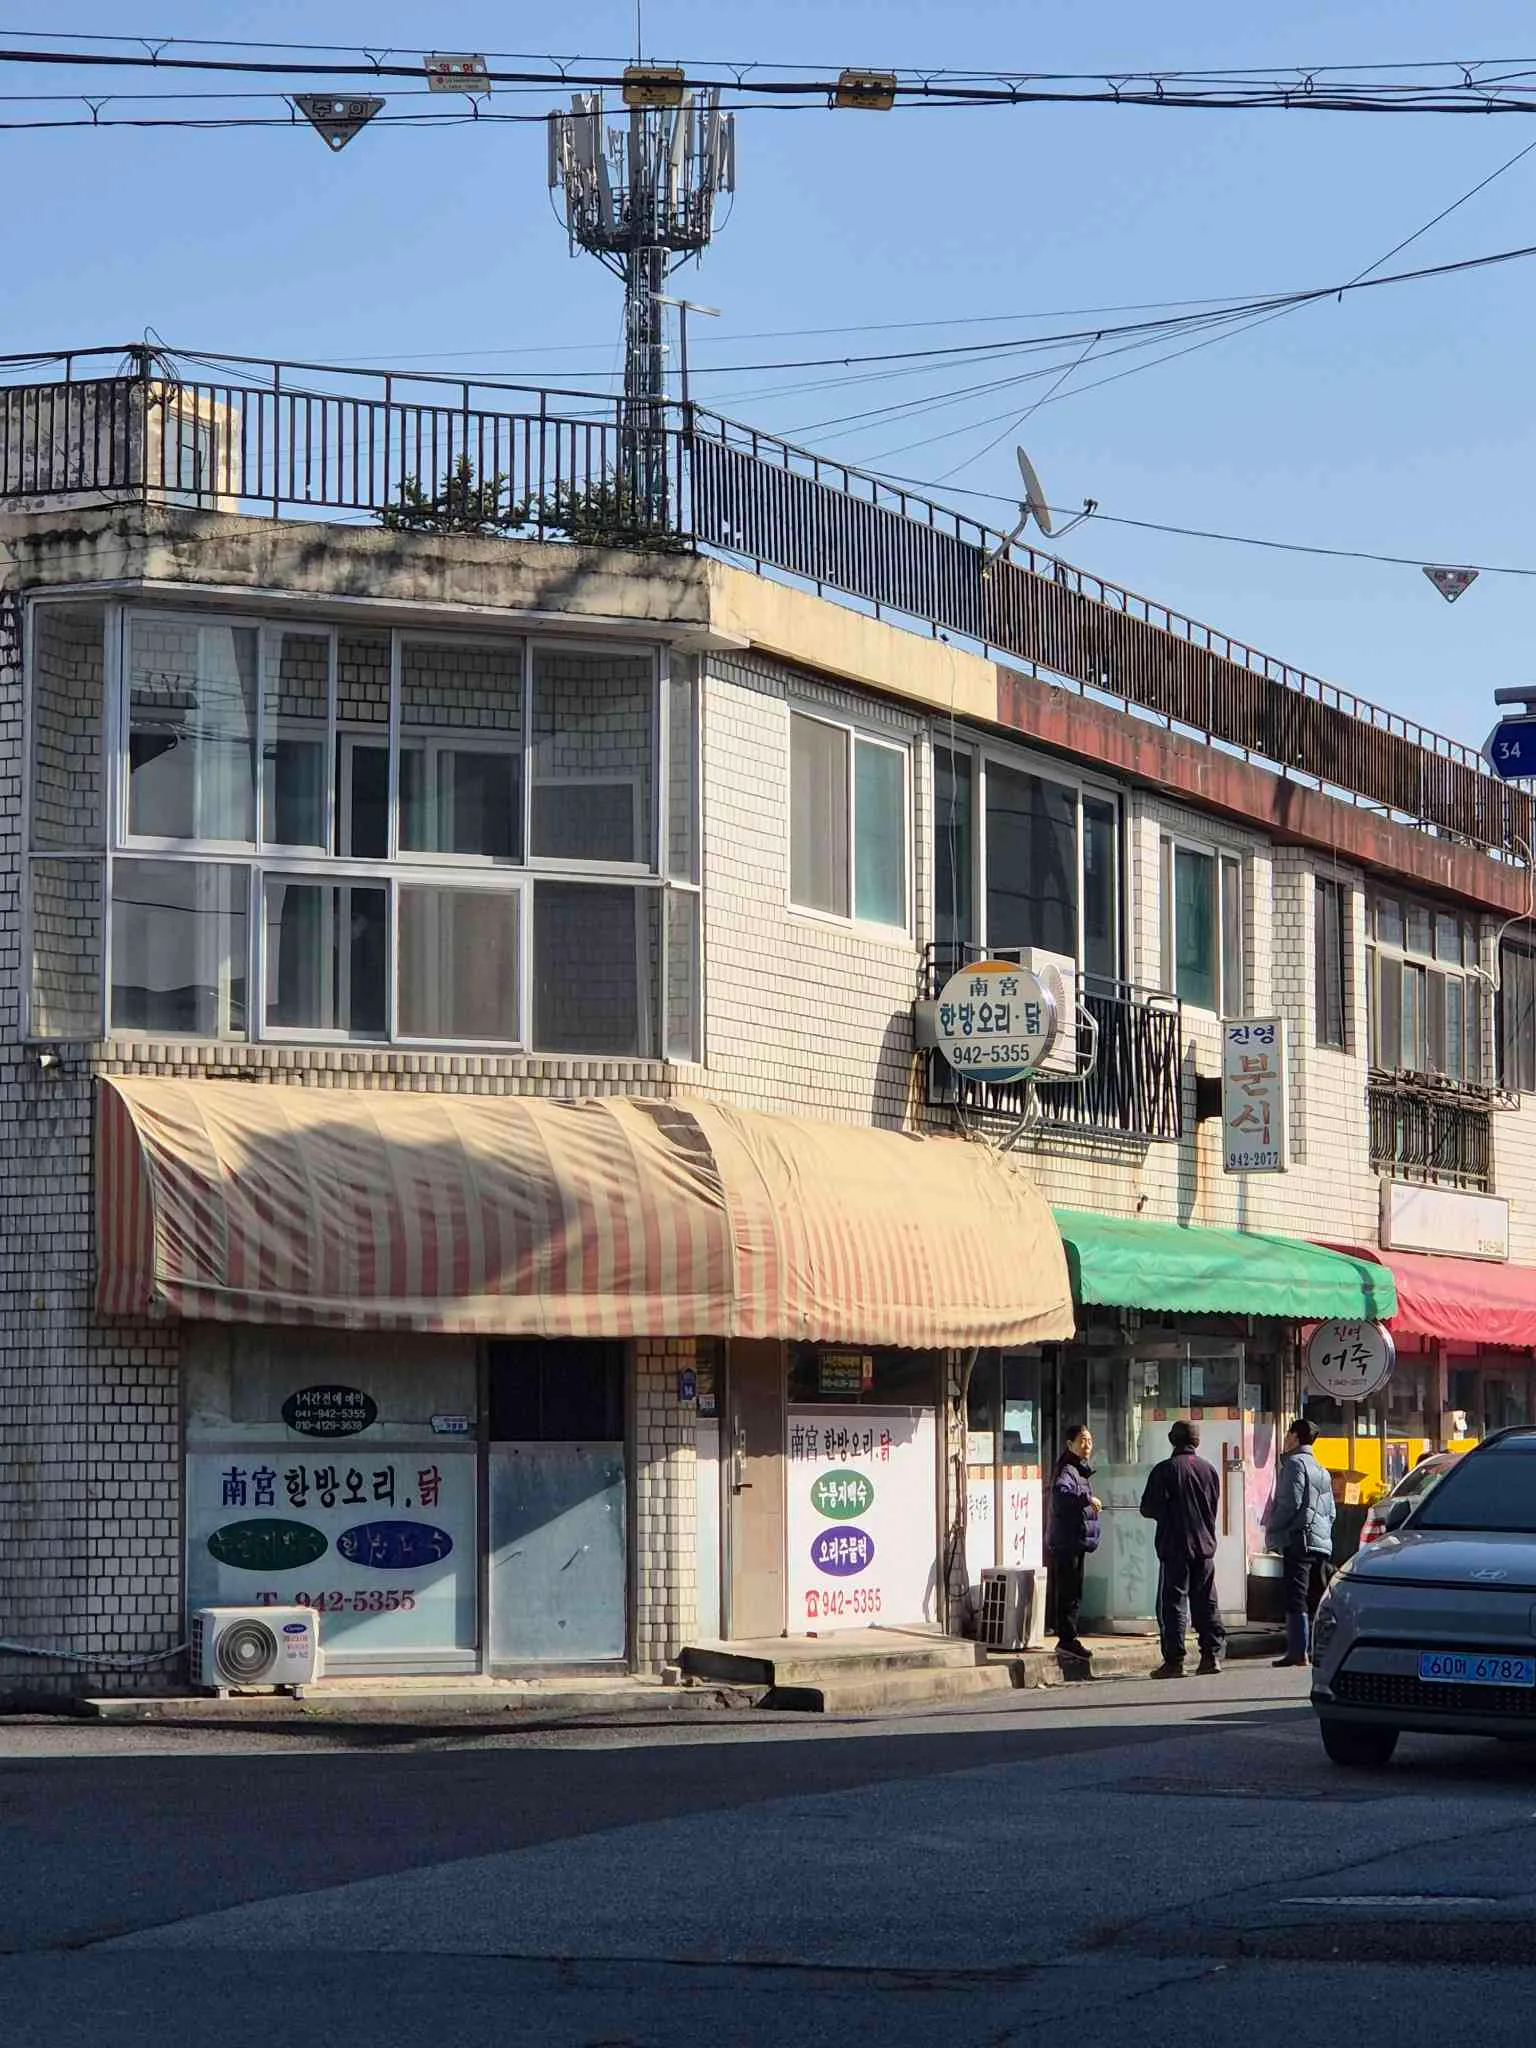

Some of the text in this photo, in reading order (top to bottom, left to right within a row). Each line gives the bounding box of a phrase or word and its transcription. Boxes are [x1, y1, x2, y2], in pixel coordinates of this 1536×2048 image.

[1500, 742, 1522, 759] 34
[1229, 1025, 1275, 1045] 진영
[953, 1044, 1030, 1064] 942-5355
[1230, 1053, 1277, 1144] 분식
[1230, 1152, 1278, 1167] 942-2077
[1322, 1343, 1373, 1376] 어죽
[295, 1589, 416, 1612] 942-5355
[822, 1588, 881, 1615] 942-5355
[1475, 1659, 1524, 1680] 6782
